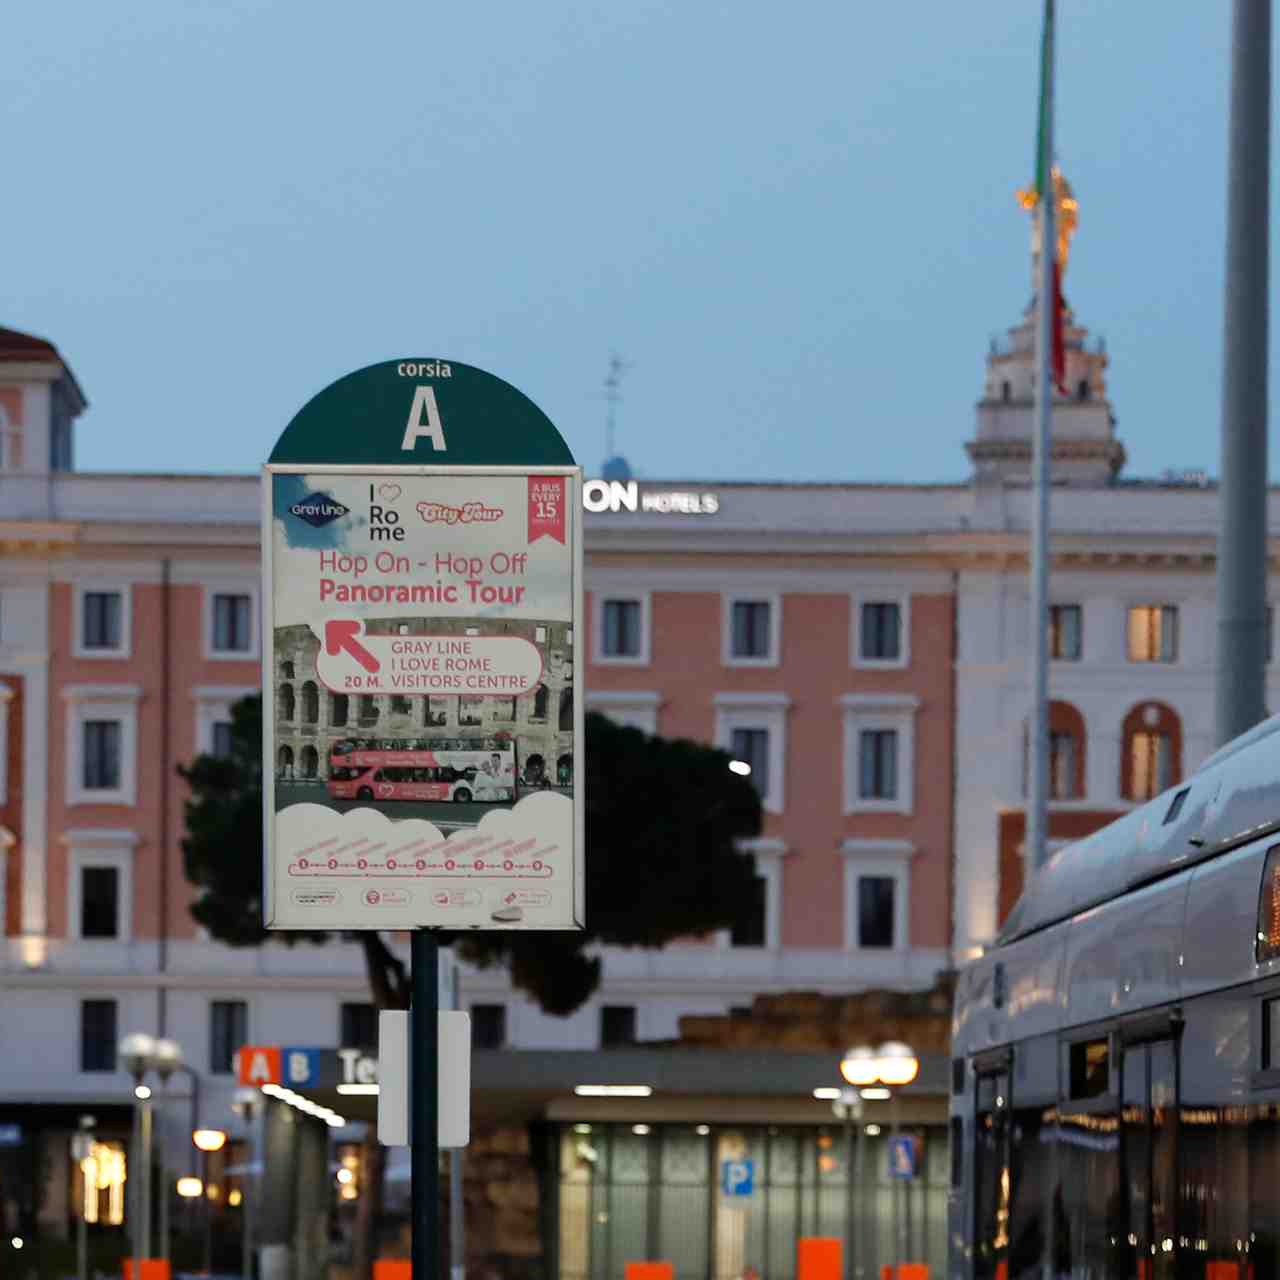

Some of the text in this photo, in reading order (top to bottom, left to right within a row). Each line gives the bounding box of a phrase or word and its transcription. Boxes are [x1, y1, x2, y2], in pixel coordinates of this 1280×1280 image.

[397, 360, 452, 378] corsia
[401, 385, 447, 451] A
[536, 502, 557, 518] 15
[320, 551, 368, 578] Hop
[375, 551, 410, 573] On
[435, 552, 483, 578] Hop
[490, 552, 528, 574] Off
[320, 578, 526, 604] Panoramic Tour
[391, 641, 471, 654] GRAY LINE
[401, 658, 439, 671] LOVE
[446, 658, 491, 671] ROME
[345, 676, 362, 688] 20
[391, 675, 528, 688] VISITORS CENTRE
[250, 1052, 271, 1080] A
[289, 1052, 310, 1083] B
